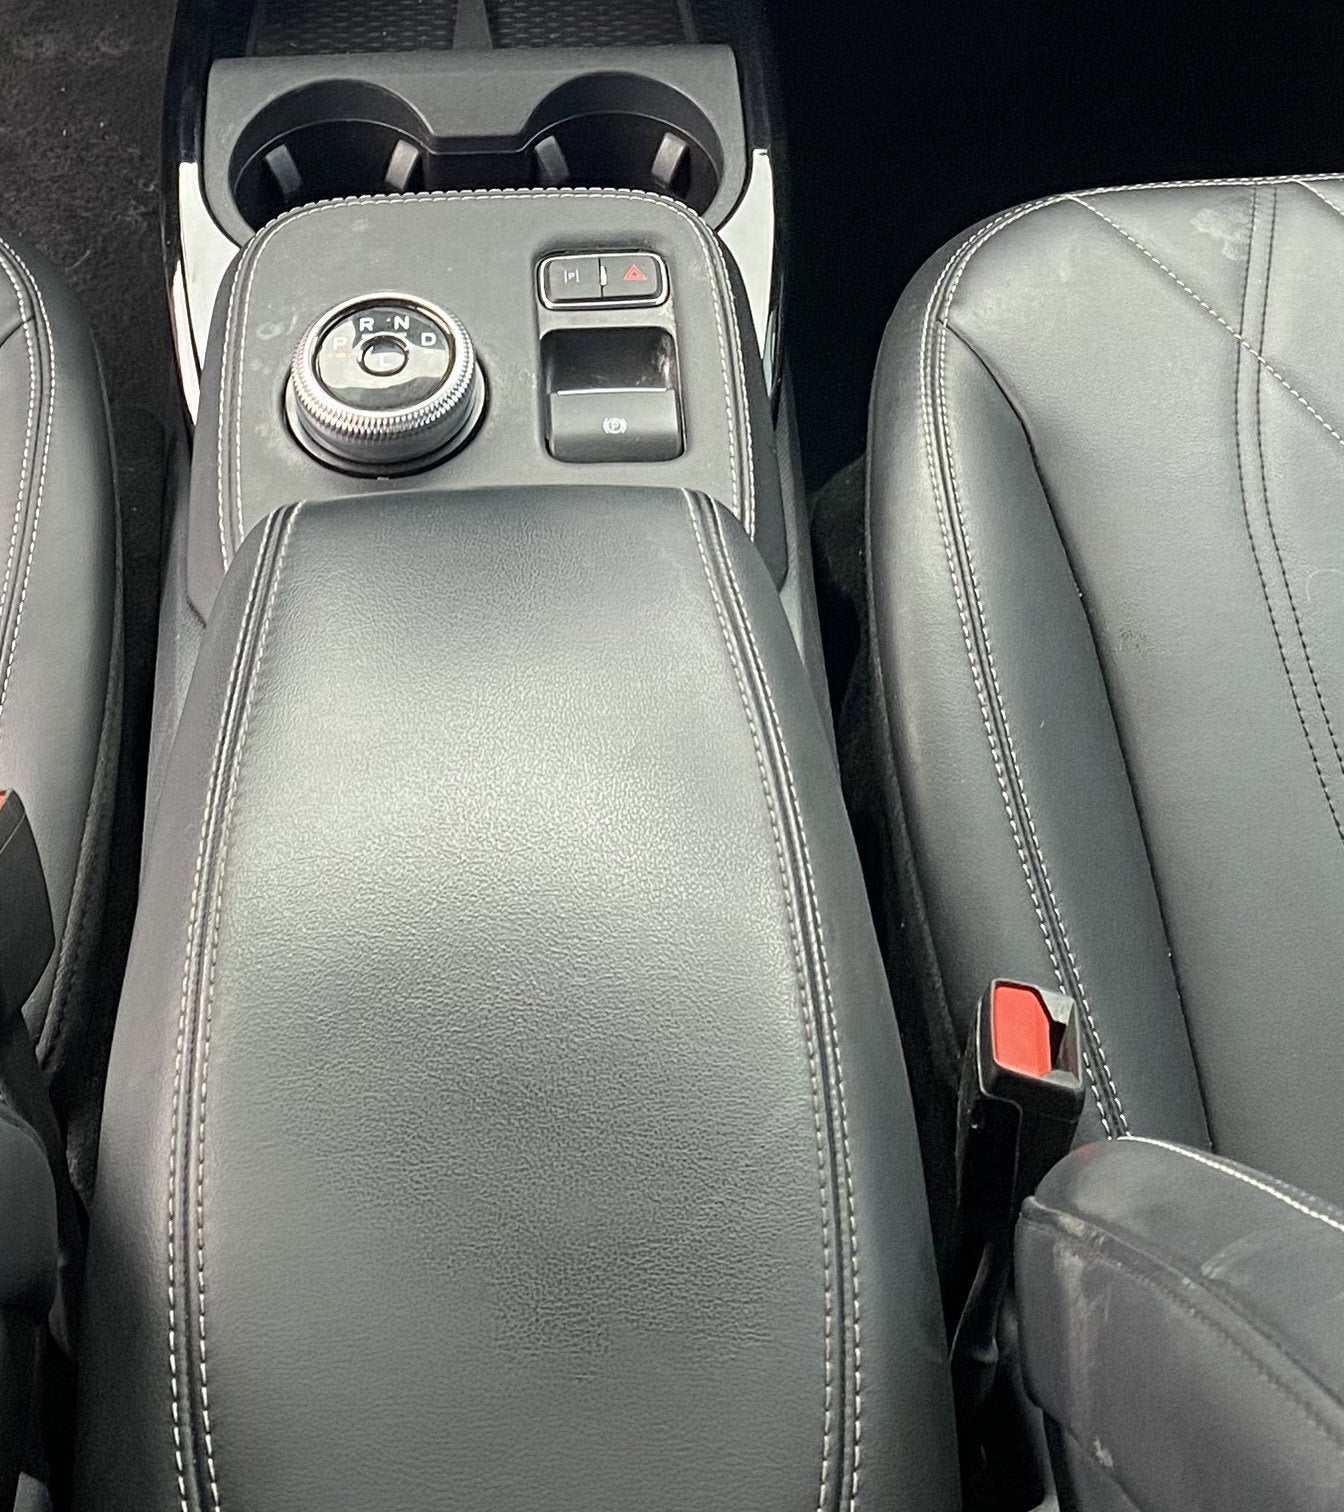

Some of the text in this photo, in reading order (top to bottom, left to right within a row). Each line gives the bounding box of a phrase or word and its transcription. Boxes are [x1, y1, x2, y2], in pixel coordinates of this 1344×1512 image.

[358, 317, 375, 332] R
[393, 315, 410, 330] N
[332, 336, 348, 350] P
[420, 332, 437, 347] D
